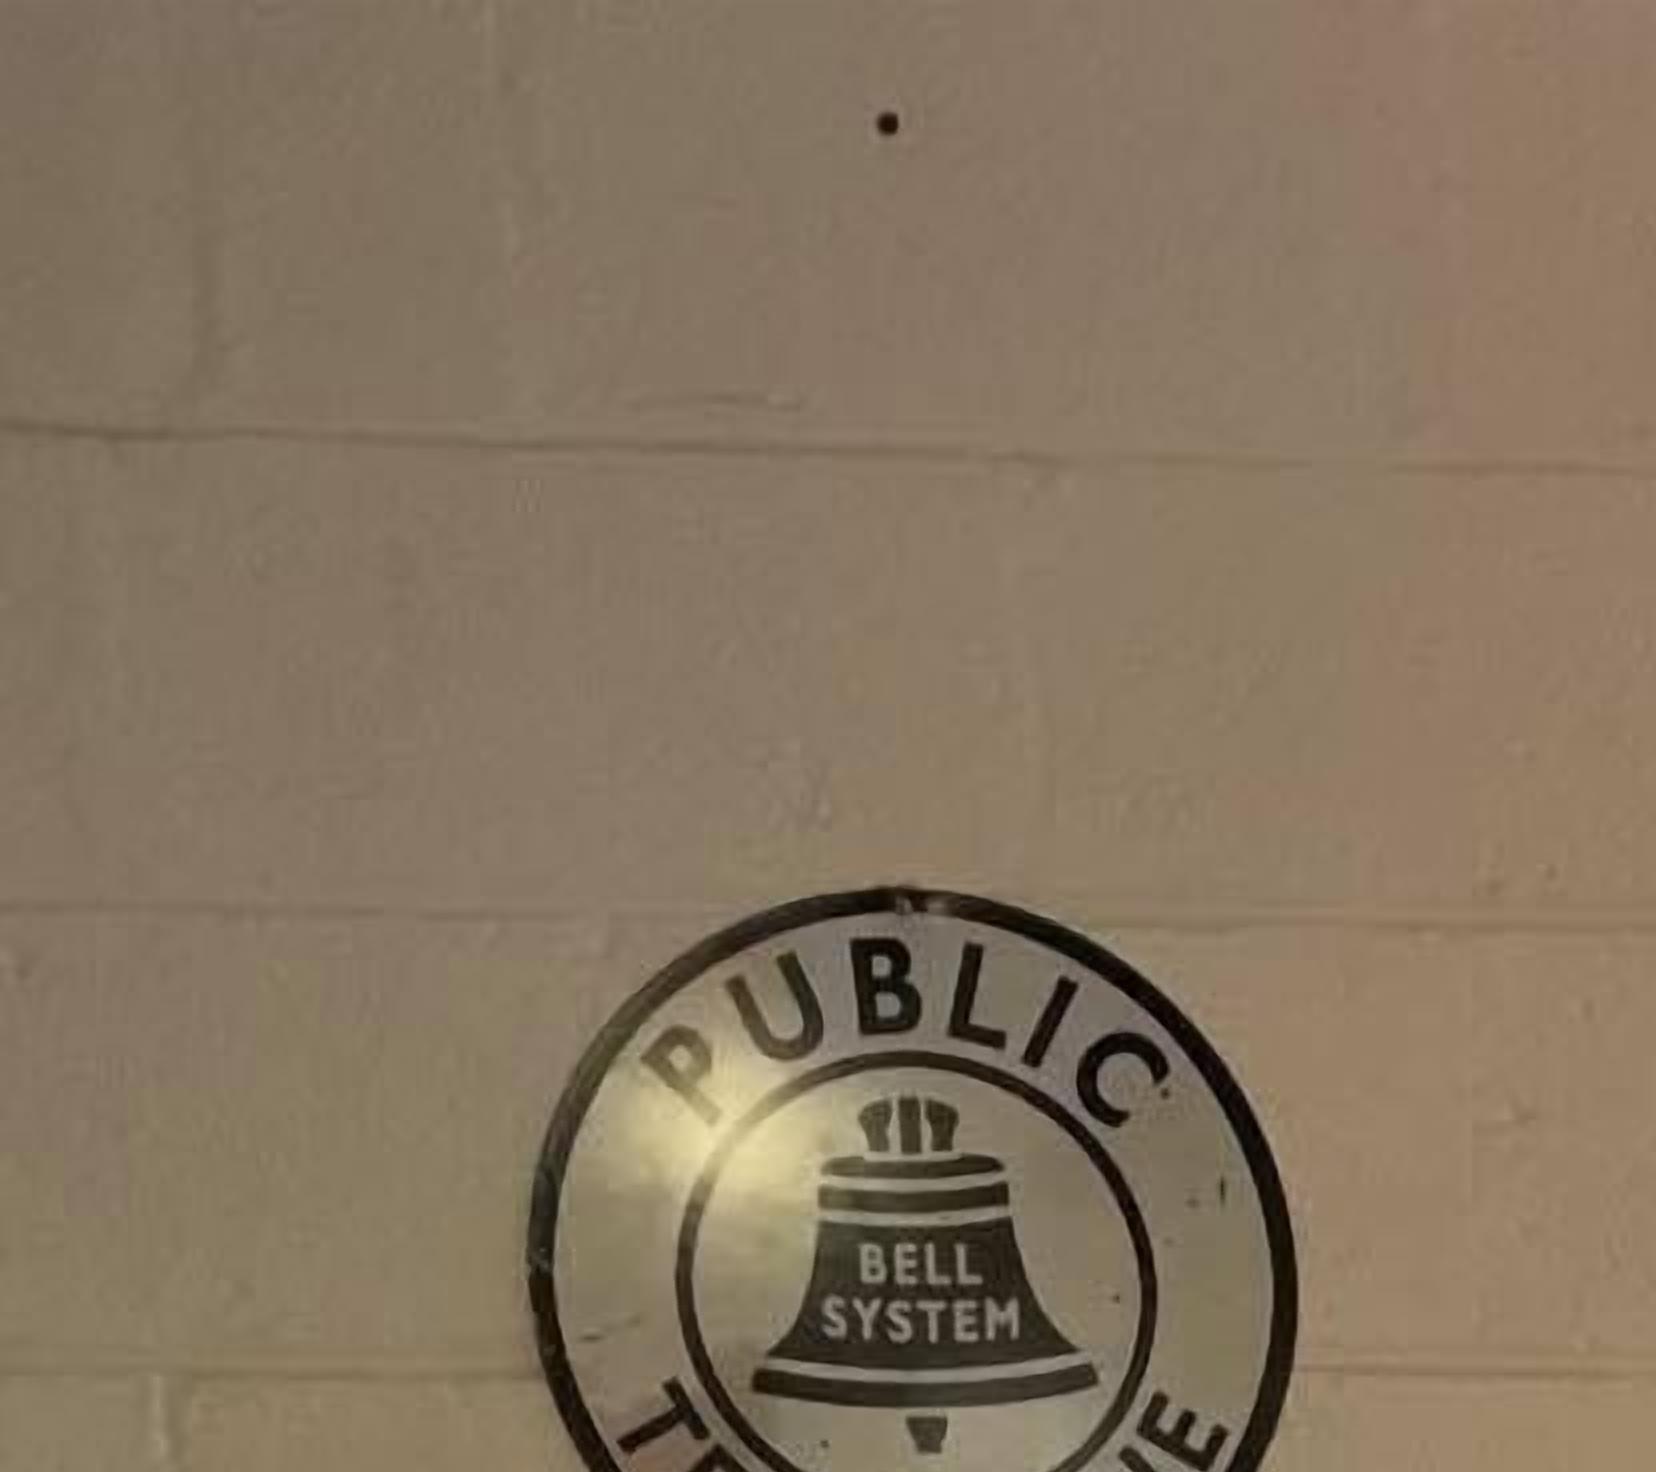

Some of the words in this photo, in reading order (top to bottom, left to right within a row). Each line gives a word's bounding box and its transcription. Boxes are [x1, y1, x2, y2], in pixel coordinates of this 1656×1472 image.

[640, 936, 1170, 1129] PUBLIC
[858, 1242, 984, 1286] BELL
[820, 1294, 1021, 1344] SYSTEM
